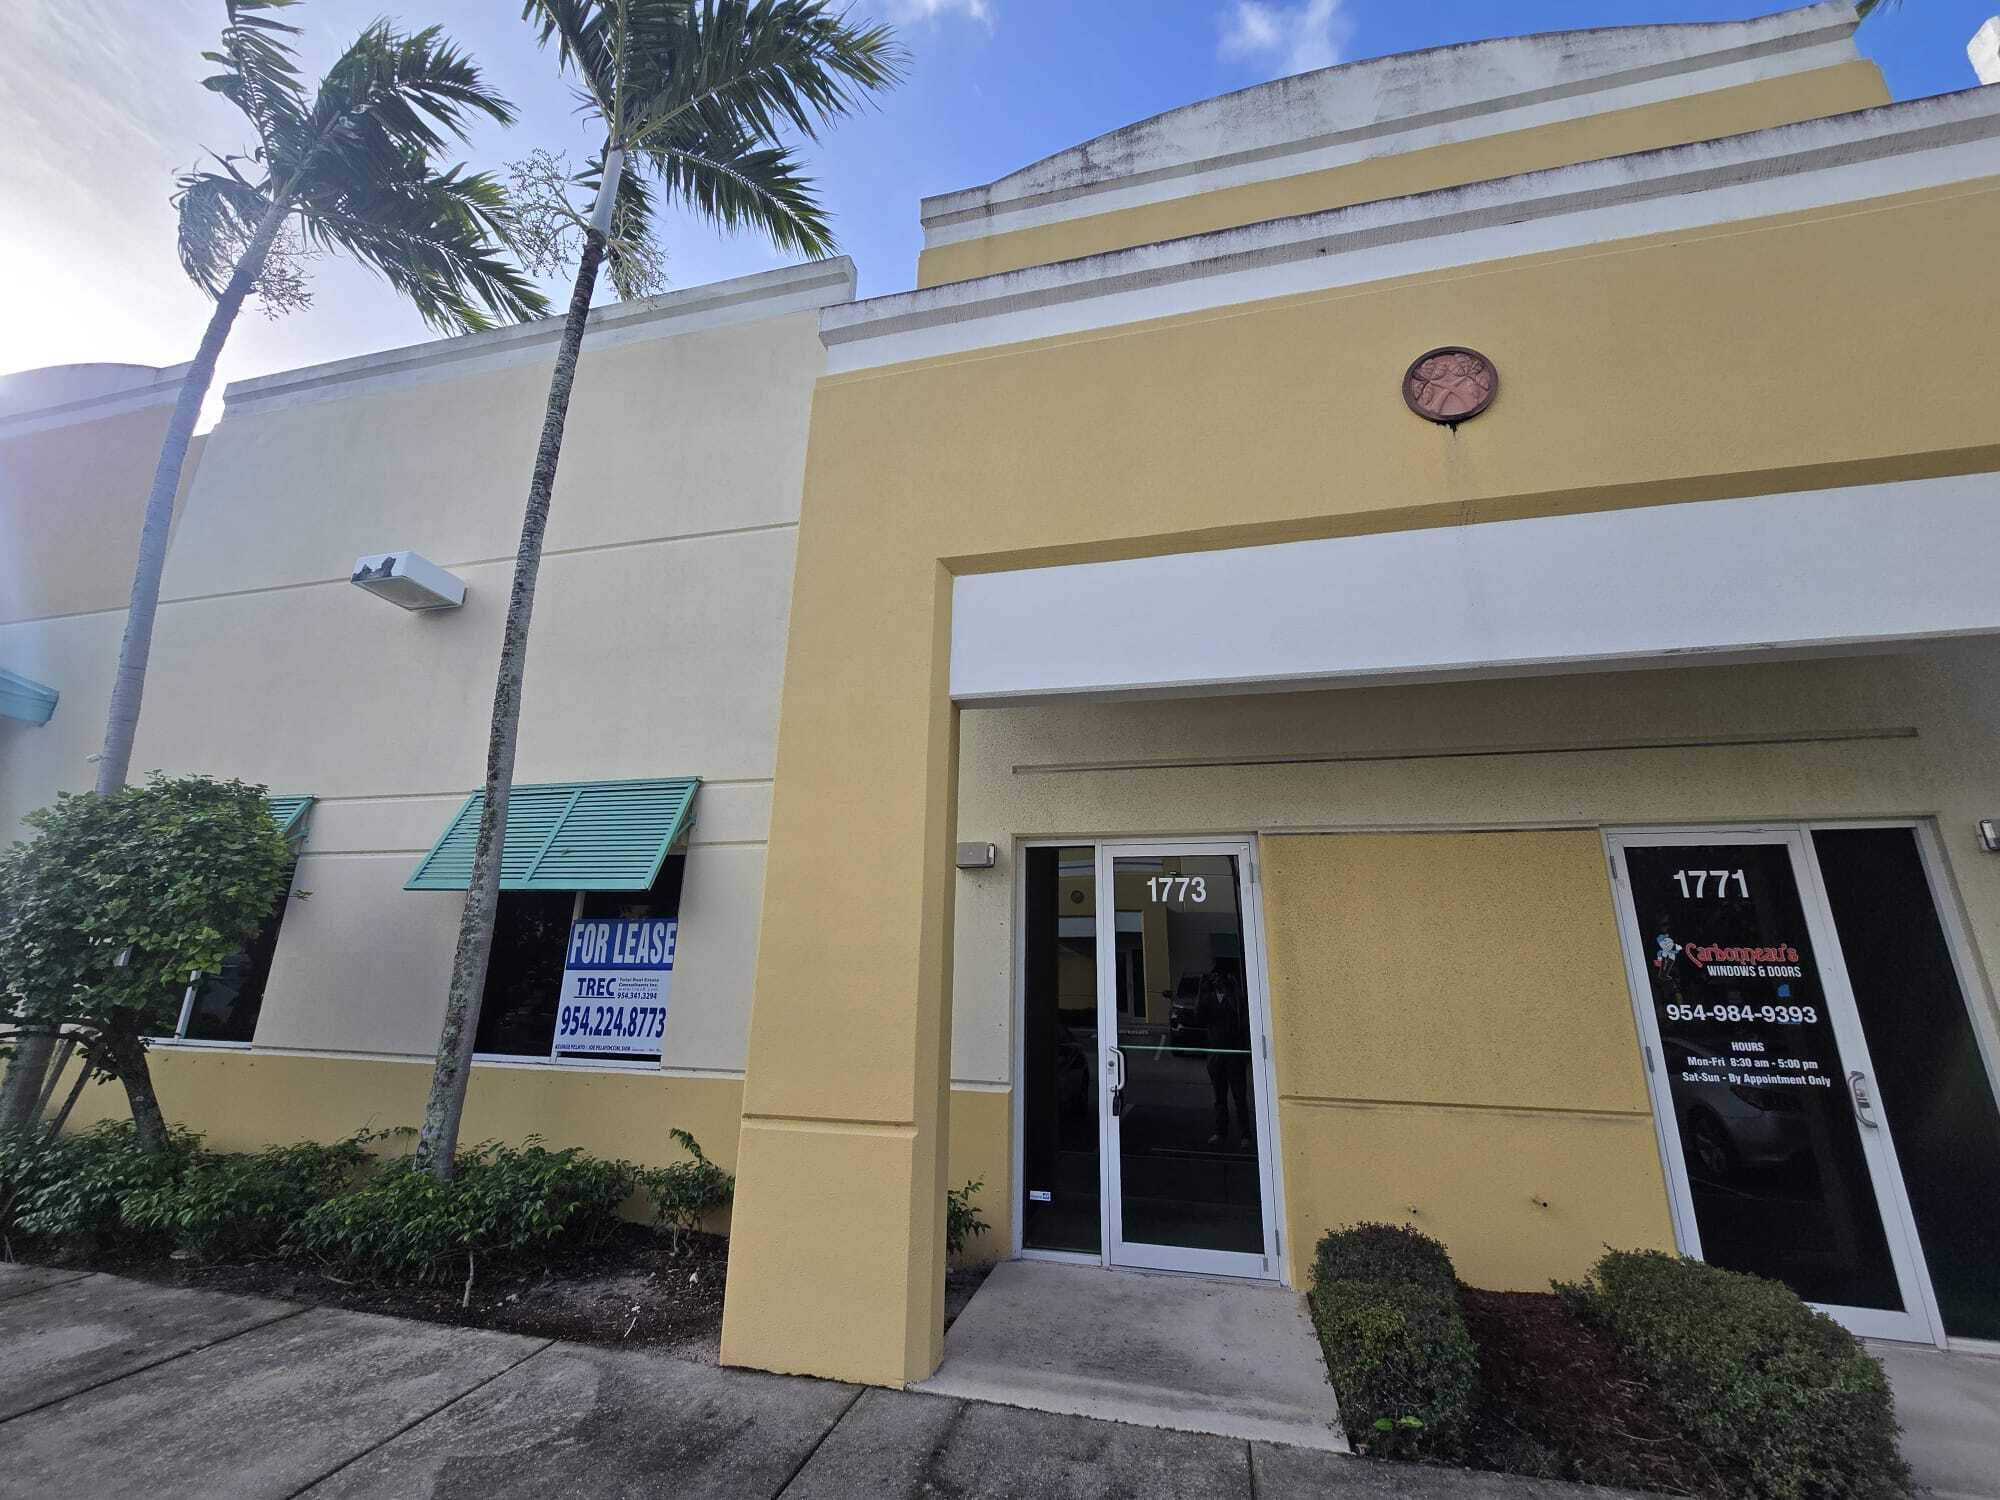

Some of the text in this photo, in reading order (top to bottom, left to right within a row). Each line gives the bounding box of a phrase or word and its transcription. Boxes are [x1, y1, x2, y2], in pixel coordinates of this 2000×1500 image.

[1147, 876, 1207, 903] 1773
[1673, 869, 1750, 899] 1771
[570, 922, 678, 964] FOR LEASE
[1685, 943, 1799, 968] Carbonneau's
[1707, 965, 1802, 978] WINDOWS & DOORS
[577, 977, 617, 997] TREC
[560, 1005, 667, 1038] 954.224.8773
[1666, 1004, 1818, 1024] 954-984-9393
[1731, 1042, 1765, 1052] HOURS
[1687, 1056, 1726, 1067] Mon-Fri
[1730, 1057, 1752, 1067] 8:30
[1754, 1060, 1769, 1068] am
[1777, 1058, 1800, 1069] 5:00
[1802, 1060, 1818, 1071] pm
[1682, 1071, 1720, 1082] Sat-Sun
[1728, 1073, 1741, 1084] By
[1743, 1073, 1807, 1086] Appointment
[1808, 1075, 1831, 1087] Only
